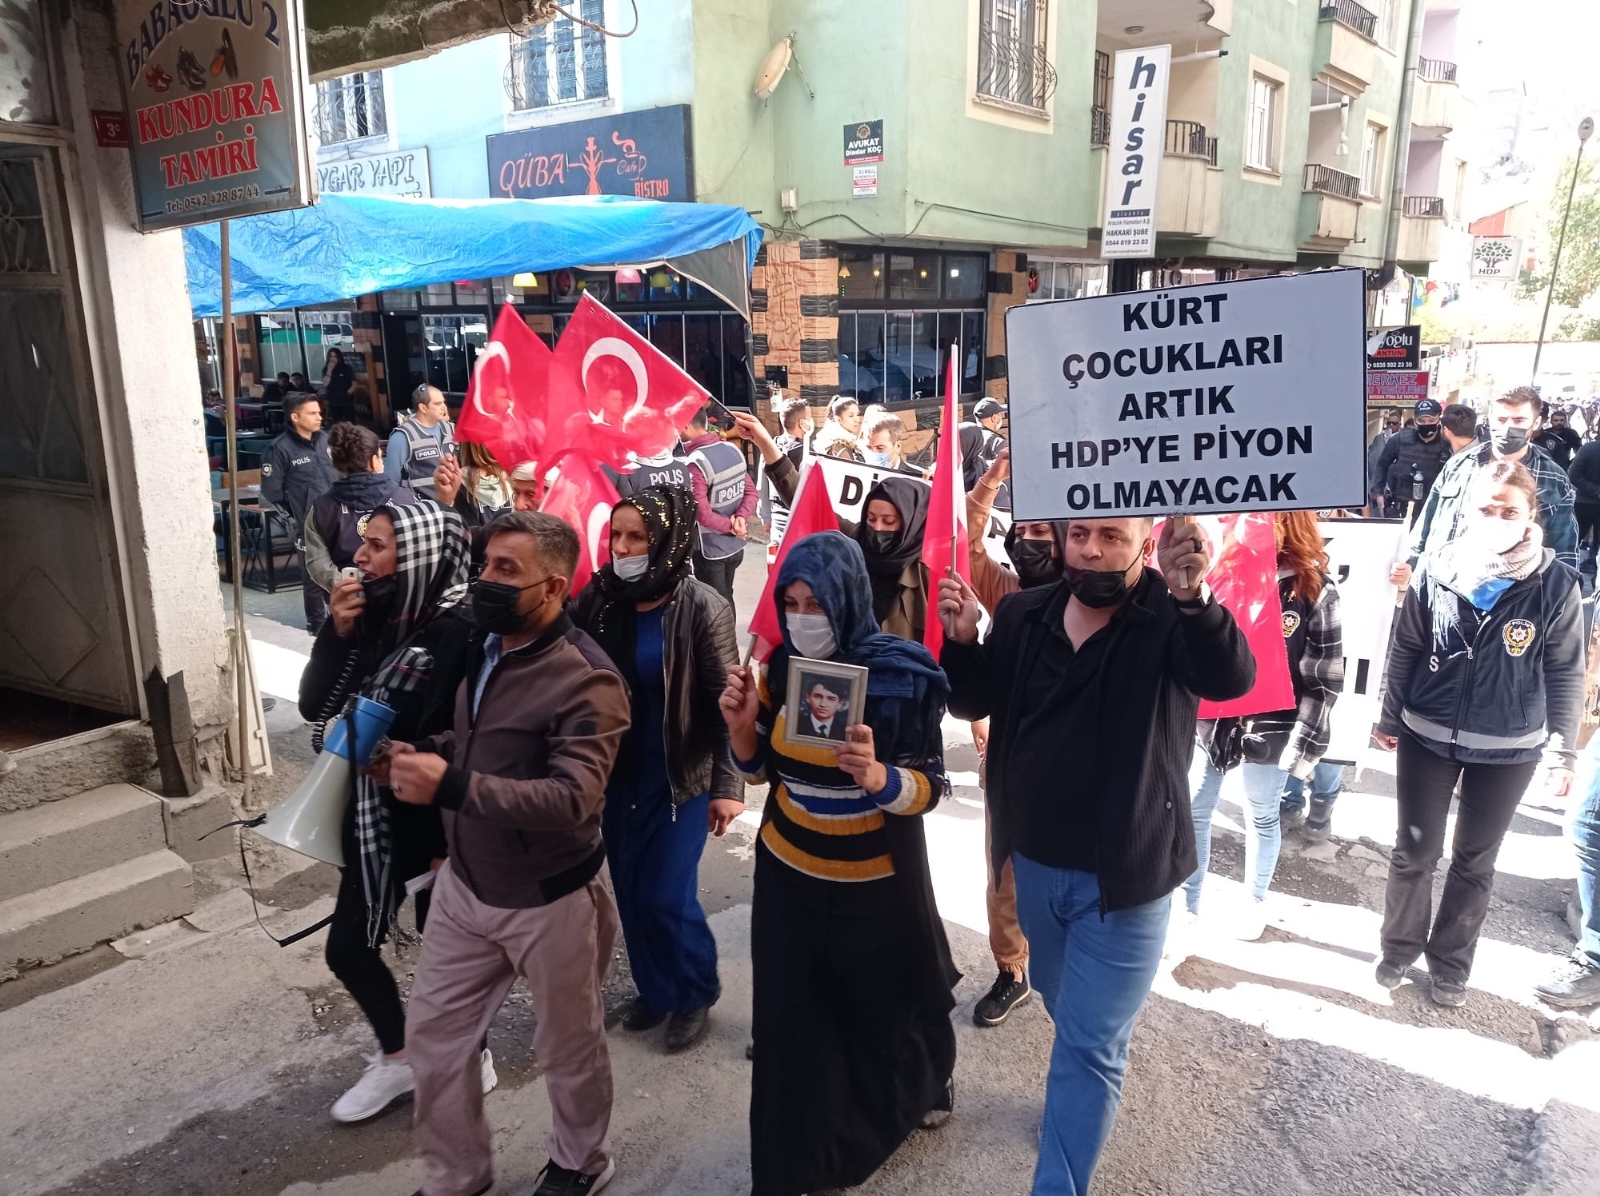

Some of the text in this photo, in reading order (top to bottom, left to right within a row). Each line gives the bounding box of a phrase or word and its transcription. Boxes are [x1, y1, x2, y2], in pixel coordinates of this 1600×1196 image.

[262, 1, 280, 47] 2
[136, 77, 283, 144] KUNDURA
[848, 137, 880, 150] AVUKAT
[1121, 55, 1156, 206] hisar
[160, 124, 260, 189] TAMİRİ
[845, 145, 882, 157] Dindar KOÇ
[317, 162, 366, 192] YGAR
[368, 154, 414, 188] YAPI
[500, 151, 565, 198] QÜBA
[166, 185, 260, 214] Tel: 0542 428 87 44
[1105, 228, 1149, 237] HAKKARİ ŞUBE
[1122, 293, 1229, 332] KÜRT
[1062, 334, 1283, 389] ÇOCUKLARI
[1118, 384, 1235, 422] ARTIK
[1193, 424, 1313, 461] PİYON
[1066, 472, 1298, 510] OLMAYACAK
